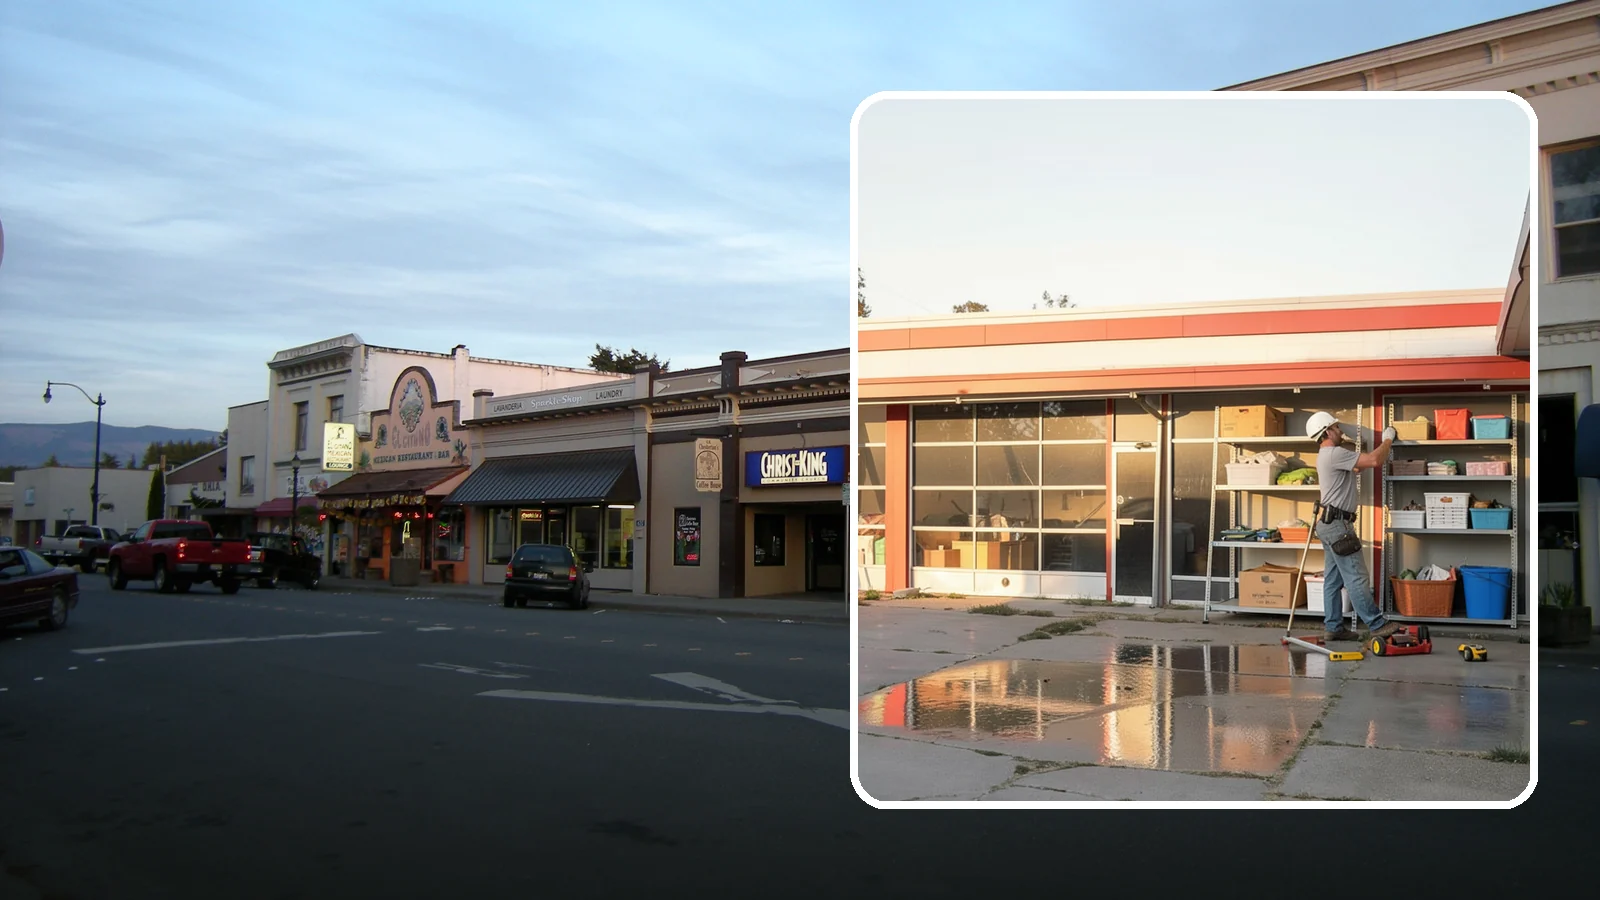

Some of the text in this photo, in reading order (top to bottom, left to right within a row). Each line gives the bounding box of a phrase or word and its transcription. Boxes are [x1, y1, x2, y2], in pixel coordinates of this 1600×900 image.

[595, 389, 623, 399] LAUNDRY
[493, 402, 522, 412] LAVANDERIA
[531, 395, 582, 408] Sparkle Shop
[373, 455, 396, 464] MEXICAN
[397, 451, 433, 462] RESTAURANT
[438, 450, 450, 459] BAR
[761, 450, 828, 477] CHRIST KING
